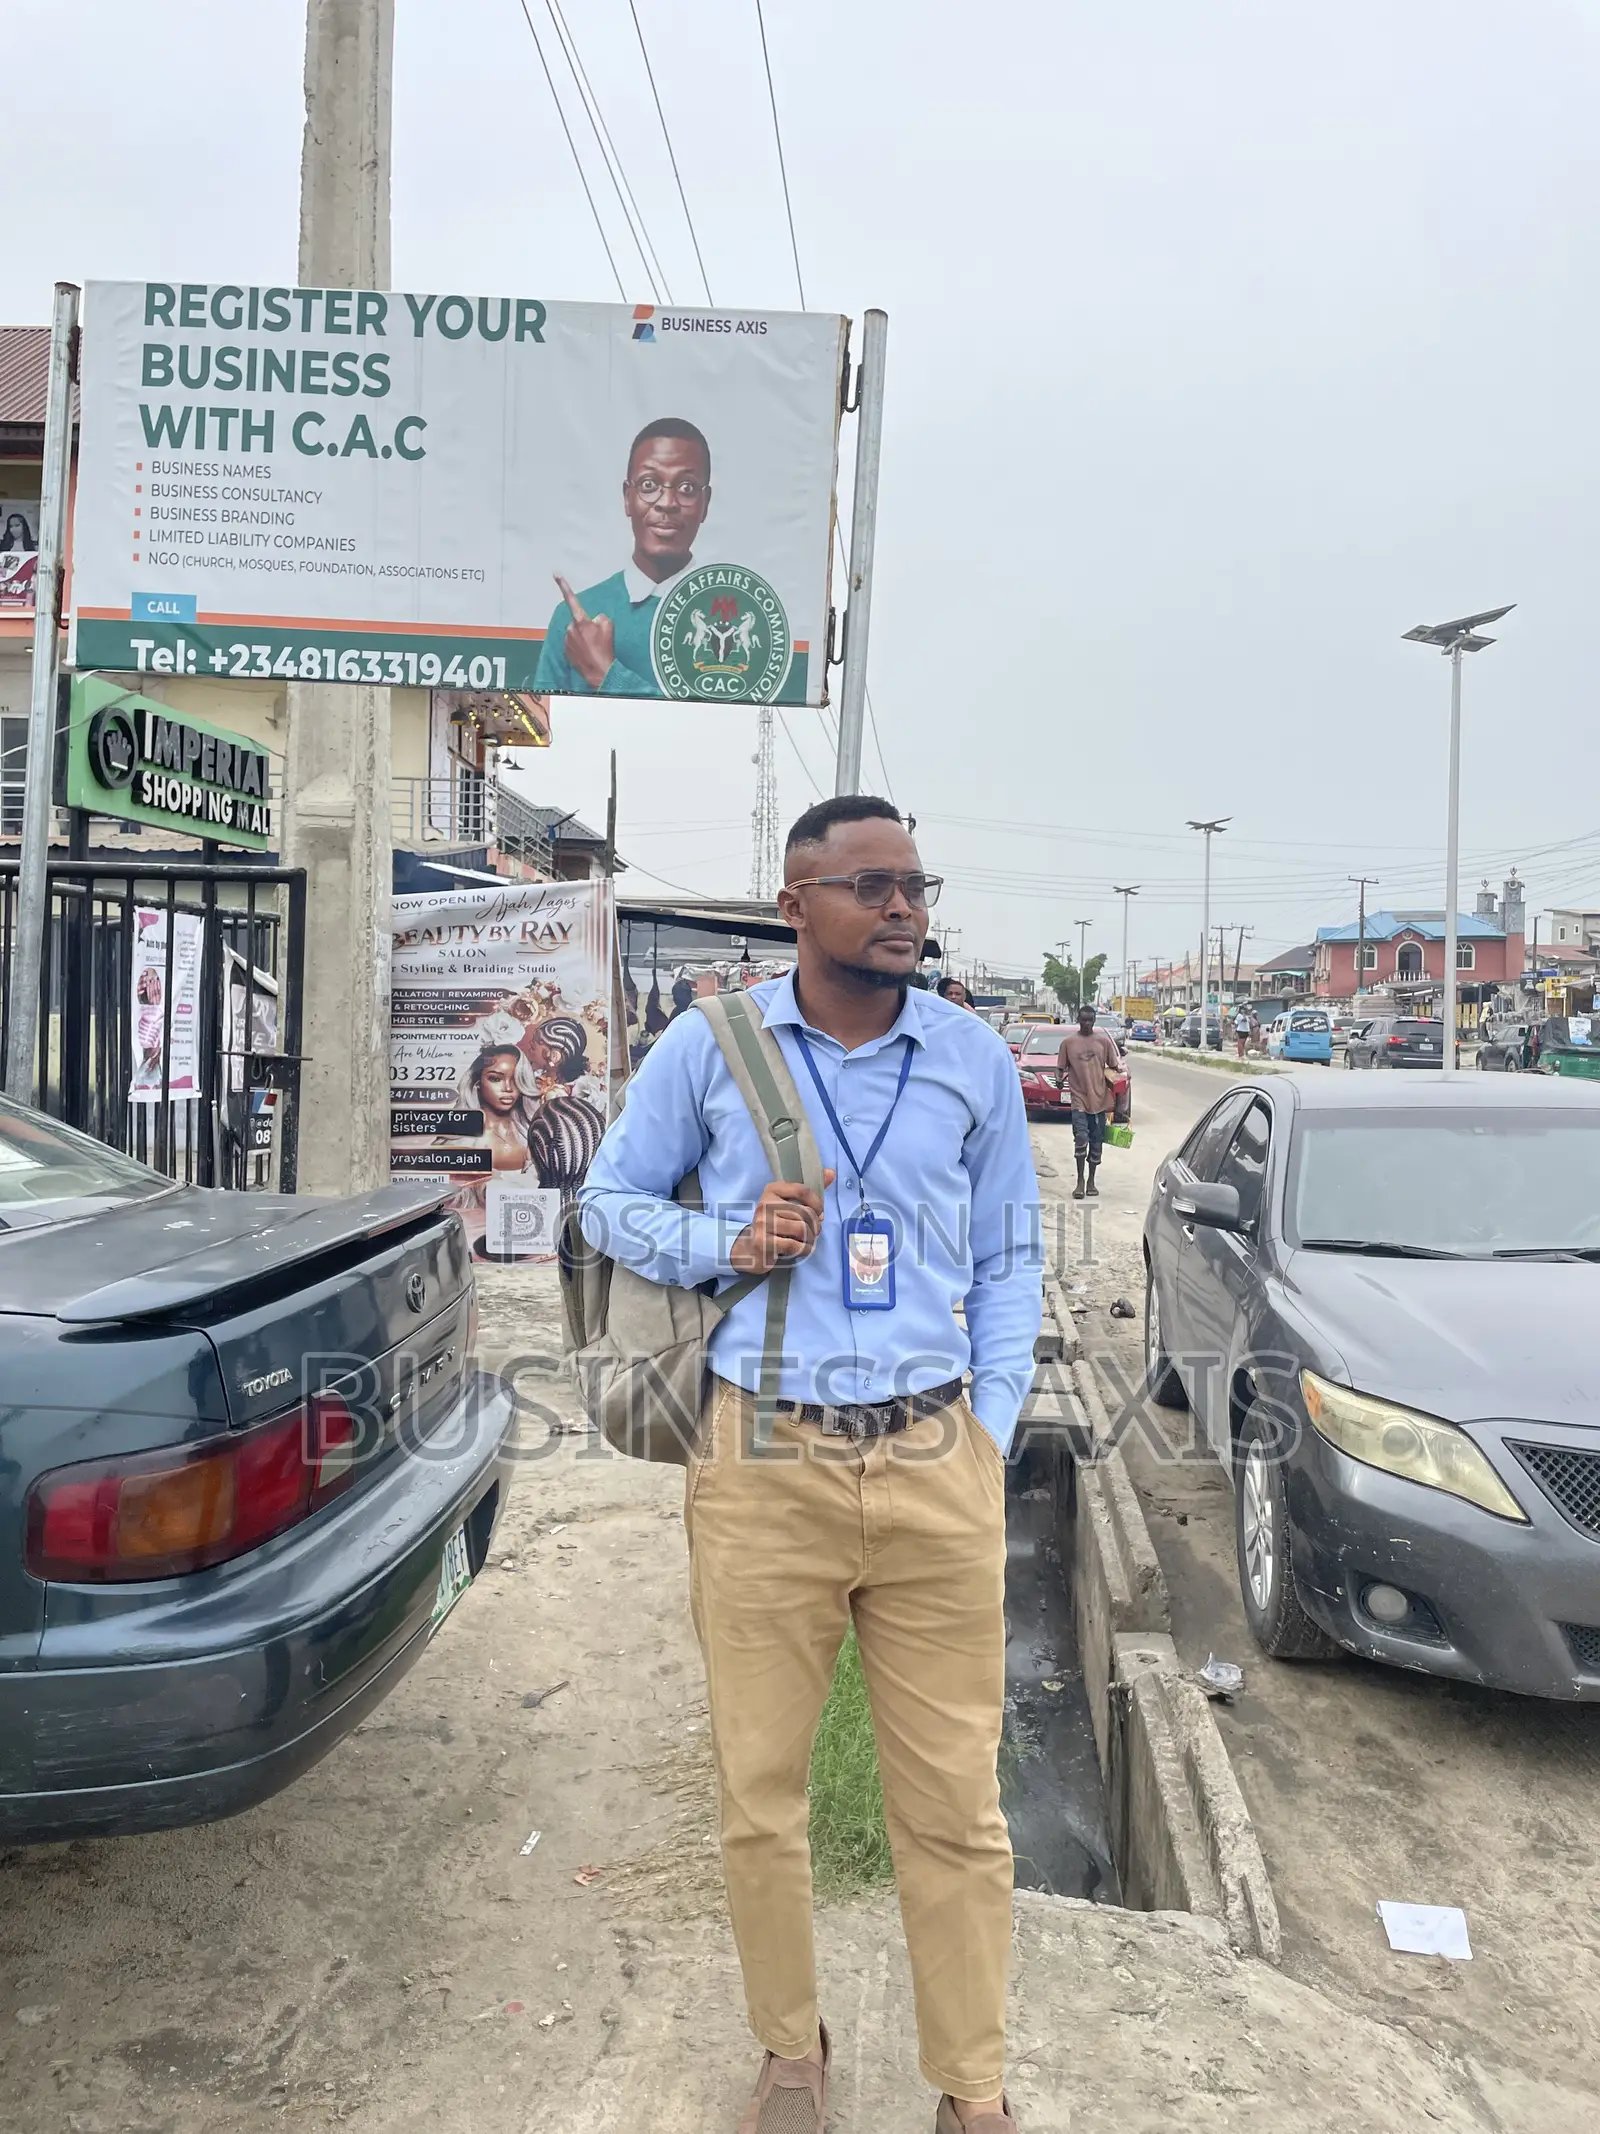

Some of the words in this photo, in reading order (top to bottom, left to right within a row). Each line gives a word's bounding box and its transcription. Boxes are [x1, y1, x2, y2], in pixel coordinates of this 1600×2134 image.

[144, 283, 388, 336] REGISTER
[407, 294, 546, 344] YOUR
[662, 317, 731, 333] BUSINESS
[735, 320, 767, 335] AXIS
[141, 343, 391, 398] BUSINESS
[139, 404, 274, 453] WITH
[292, 411, 428, 461] C.A.C
[152, 461, 219, 477] BUSINESS
[223, 464, 272, 479] NAMES
[151, 484, 218, 499] BUSINESS
[221, 487, 323, 504] CONSULTANCY
[150, 506, 217, 522] BUSINESS
[221, 509, 295, 526] BRANDING
[149, 529, 204, 544] LIMITED
[208, 531, 271, 547] LIABILITY
[273, 535, 356, 552] COMPANIES
[149, 551, 180, 565] NGO
[182, 555, 236, 570] (CHURCH,
[239, 558, 297, 574] MOSQUES,
[300, 560, 376, 576] FOUNDATION,
[378, 565, 458, 580] ASSOCIATIONS
[461, 569, 485, 583] ETC)
[147, 600, 180, 615] CALL
[660, 592, 691, 699] CORPORATE
[689, 571, 751, 595] AFFAIRS
[750, 586, 785, 702] COMMISSION
[130, 639, 197, 675] Tel:
[209, 643, 507, 688] +2348163319401
[701, 677, 740, 693] CAC
[141, 710, 273, 800] IMPERIAL
[142, 770, 233, 824] SHOPPING
[237, 800, 275, 837] MALL
[392, 900, 423, 910] NOW
[428, 895, 467, 906] OPEN
[472, 895, 487, 903] IN
[530, 890, 577, 918] Lagos
[487, 924, 516, 942] BY
[518, 920, 575, 951] RAY
[438, 948, 488, 958] SALON
[401, 963, 444, 975] Styling
[448, 964, 457, 973] &
[463, 964, 515, 975] Braiding
[518, 964, 556, 973] Studio
[394, 1003, 401, 1011] &
[404, 1003, 470, 1011] RETOUCHING
[394, 1045, 414, 1061] Are
[414, 1066, 456, 1081] 2372
[419, 1091, 450, 1100] Light
[395, 1111, 444, 1124] privacy
[448, 1110, 468, 1121] for
[392, 1123, 436, 1133] sisters
[391, 1153, 481, 1166] yraysalon_ajah
[243, 1367, 294, 1398] TOYOTA
